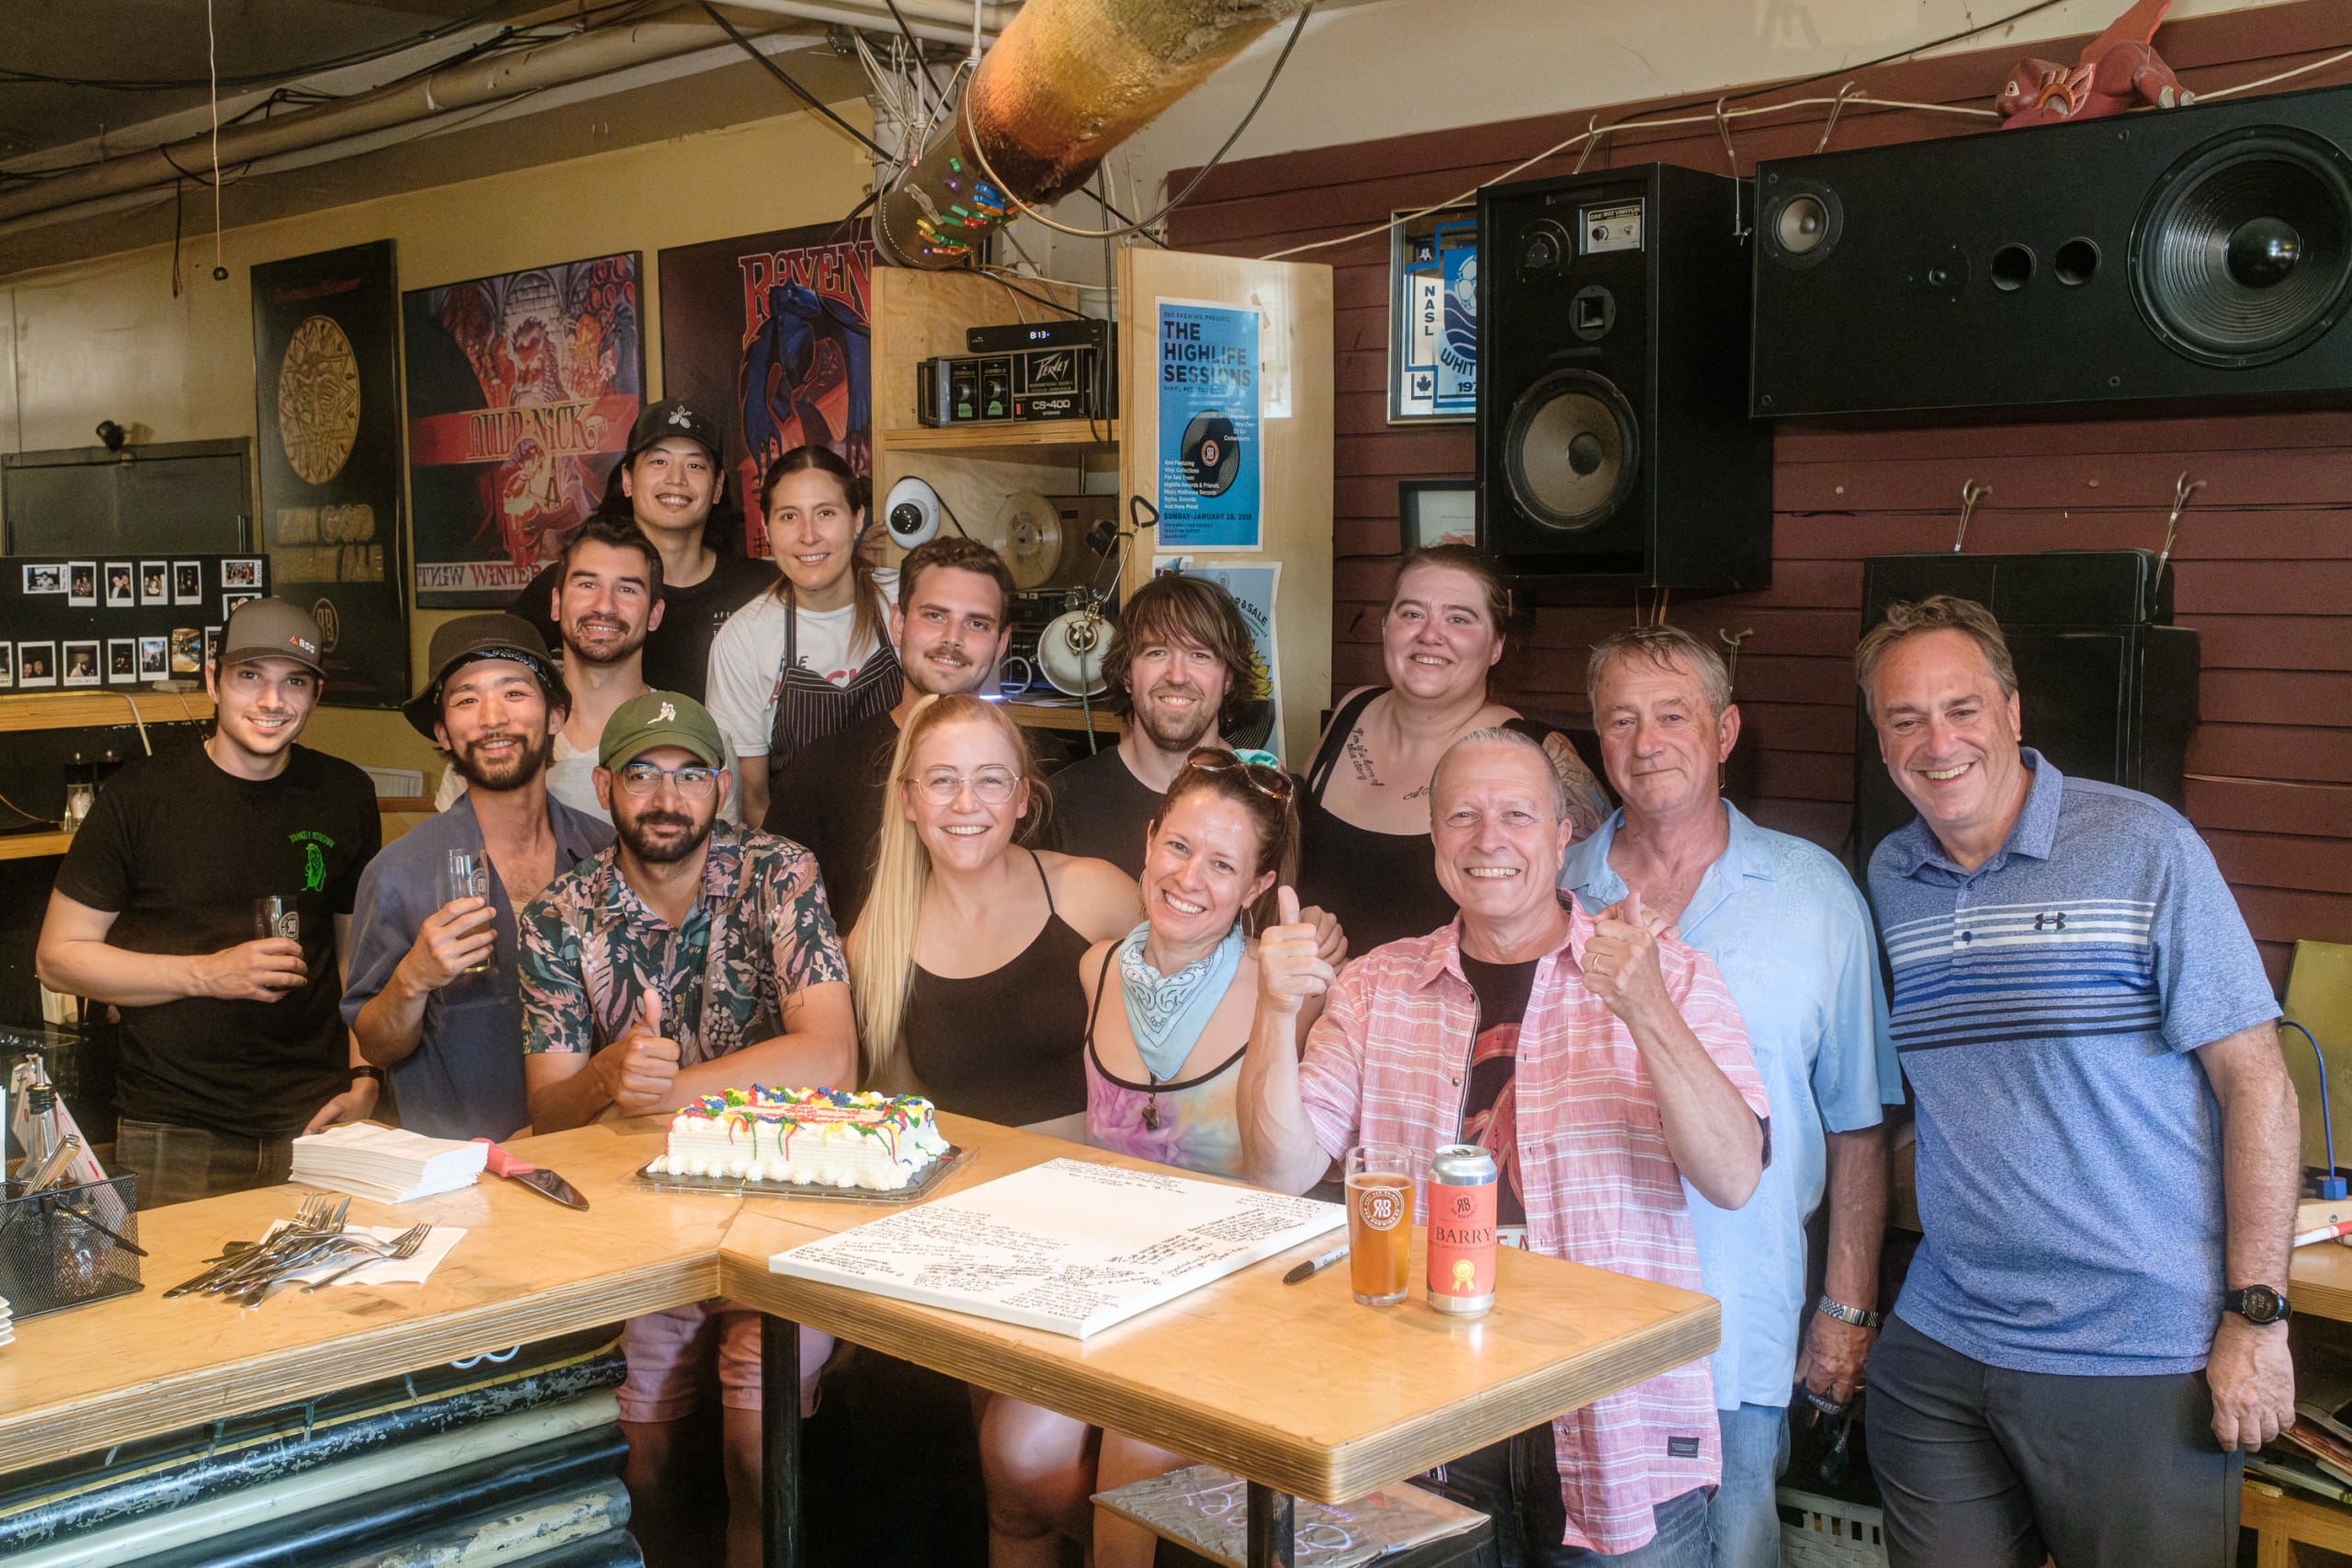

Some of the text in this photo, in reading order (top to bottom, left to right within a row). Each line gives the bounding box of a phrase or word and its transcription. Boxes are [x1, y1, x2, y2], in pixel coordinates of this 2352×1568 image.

[739, 241, 872, 351] RAVEN
[1425, 286, 1435, 336] NASL
[1164, 321, 1200, 341] THE
[1164, 343, 1247, 367] HIGHLIFE
[1164, 364, 1250, 387] SESSIONS
[1033, 399, 1070, 410] CS-400
[1247, 604, 1268, 626] SALE
[1435, 1226, 1492, 1244] BARRY
